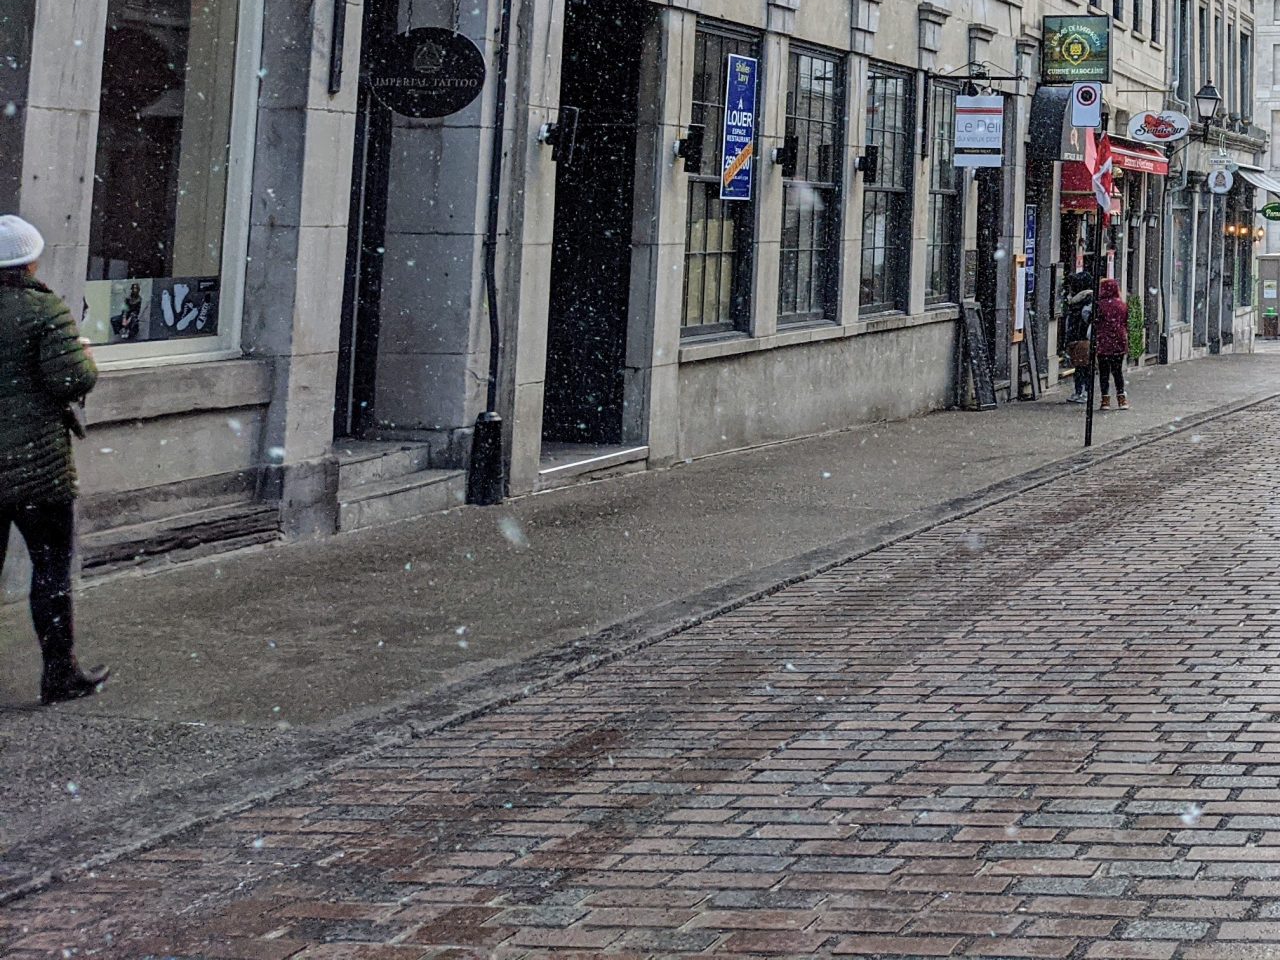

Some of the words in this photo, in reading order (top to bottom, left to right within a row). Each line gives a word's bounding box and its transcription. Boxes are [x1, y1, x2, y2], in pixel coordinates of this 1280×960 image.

[374, 77, 429, 88] IMPERIAL
[433, 77, 479, 88] TATTOO
[727, 110, 753, 128] LOUER
[956, 119, 973, 133] Le
[726, 134, 751, 143] RESTAURANT
